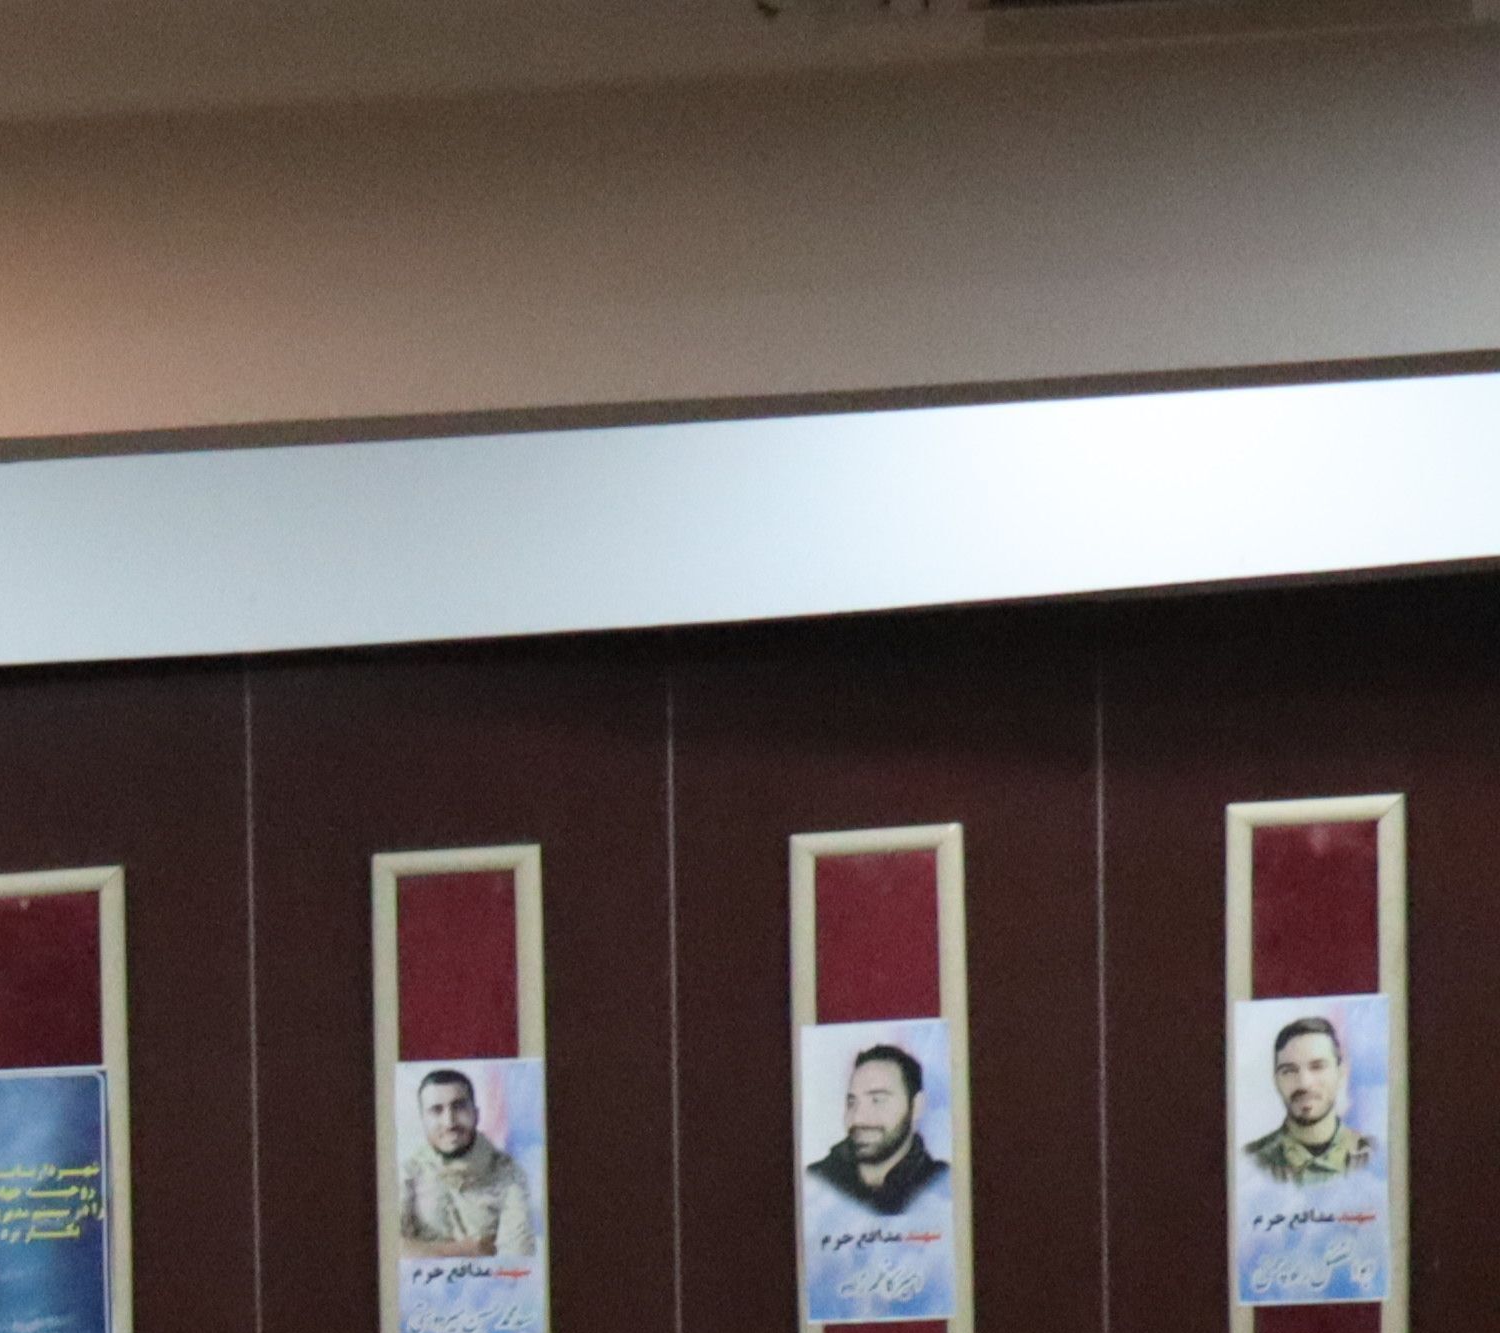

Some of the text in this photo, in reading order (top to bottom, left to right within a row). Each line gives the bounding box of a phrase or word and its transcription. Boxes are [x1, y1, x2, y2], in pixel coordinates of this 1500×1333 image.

[1252, 1213, 1287, 1233] حرم
[1288, 1207, 1336, 1232] مدافع
[820, 1233, 855, 1252] حرم
[856, 1228, 903, 1251] مدافع
[411, 1266, 445, 1286] حرم
[445, 1262, 494, 1285] مدافع
